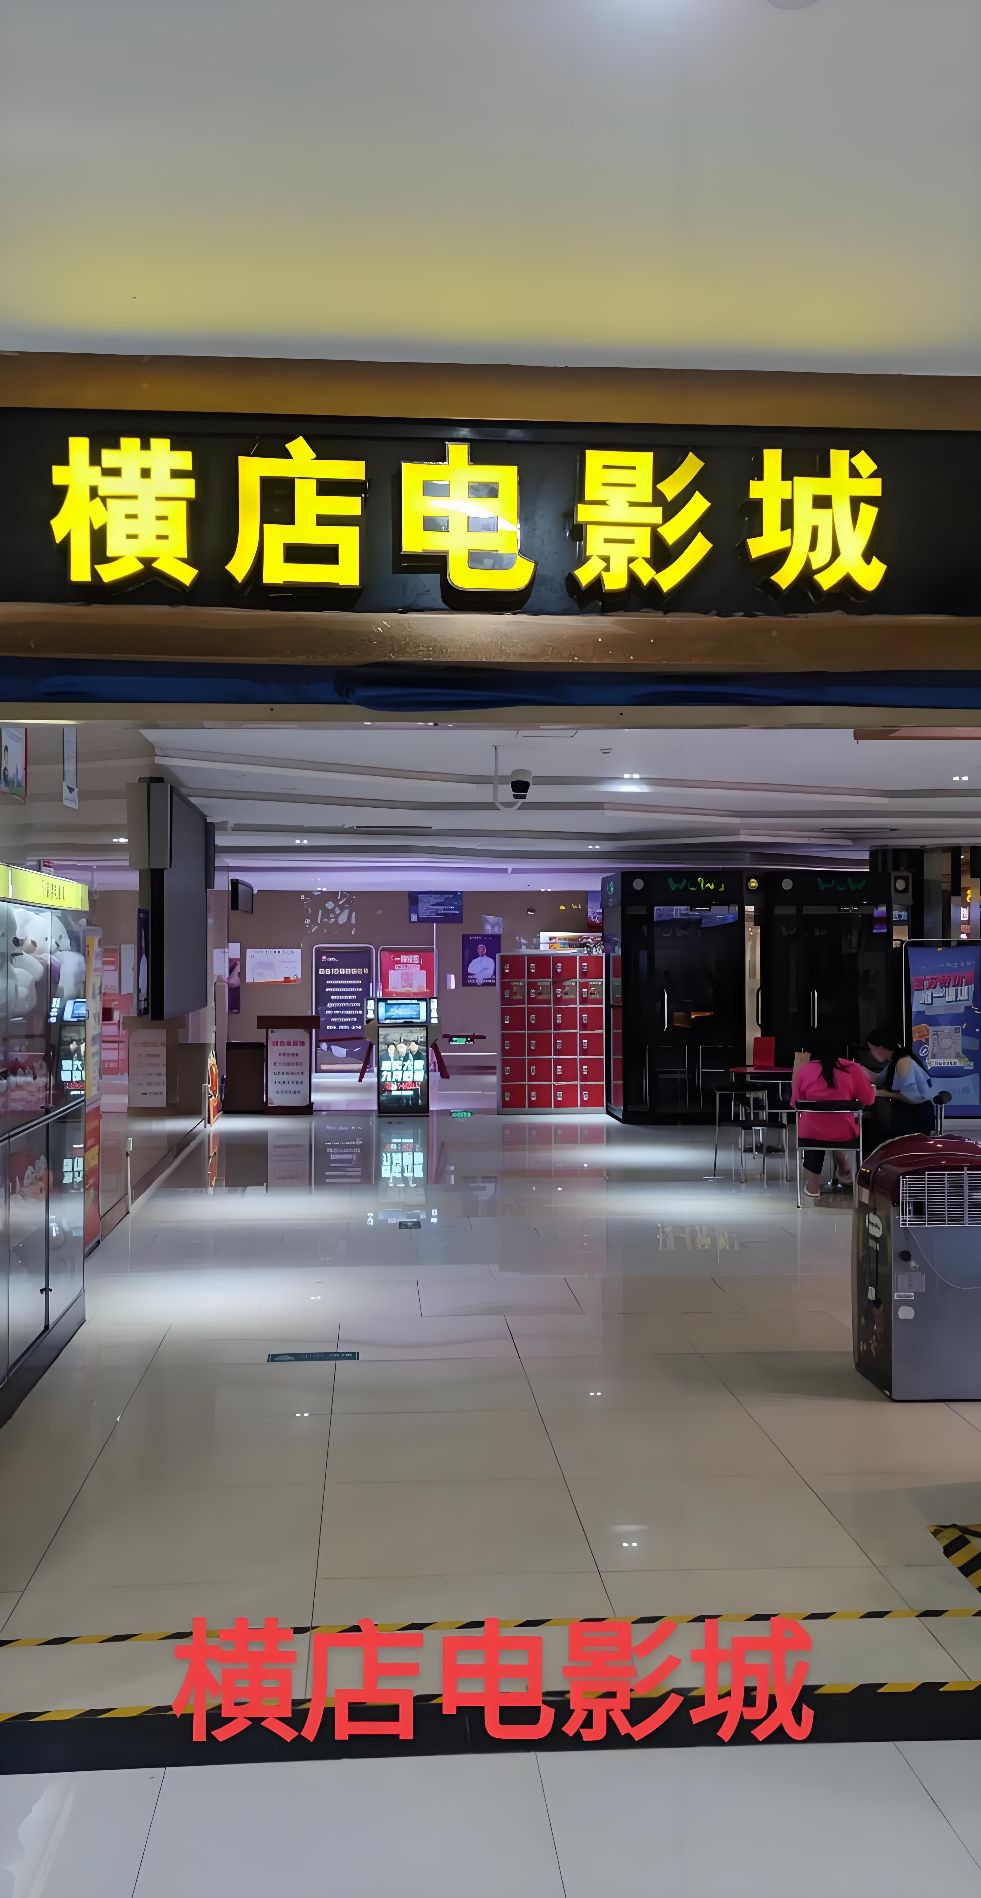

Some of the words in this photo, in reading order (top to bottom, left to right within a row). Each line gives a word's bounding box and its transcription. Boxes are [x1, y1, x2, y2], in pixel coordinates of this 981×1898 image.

[50, 436, 887, 592] 横店电影城
